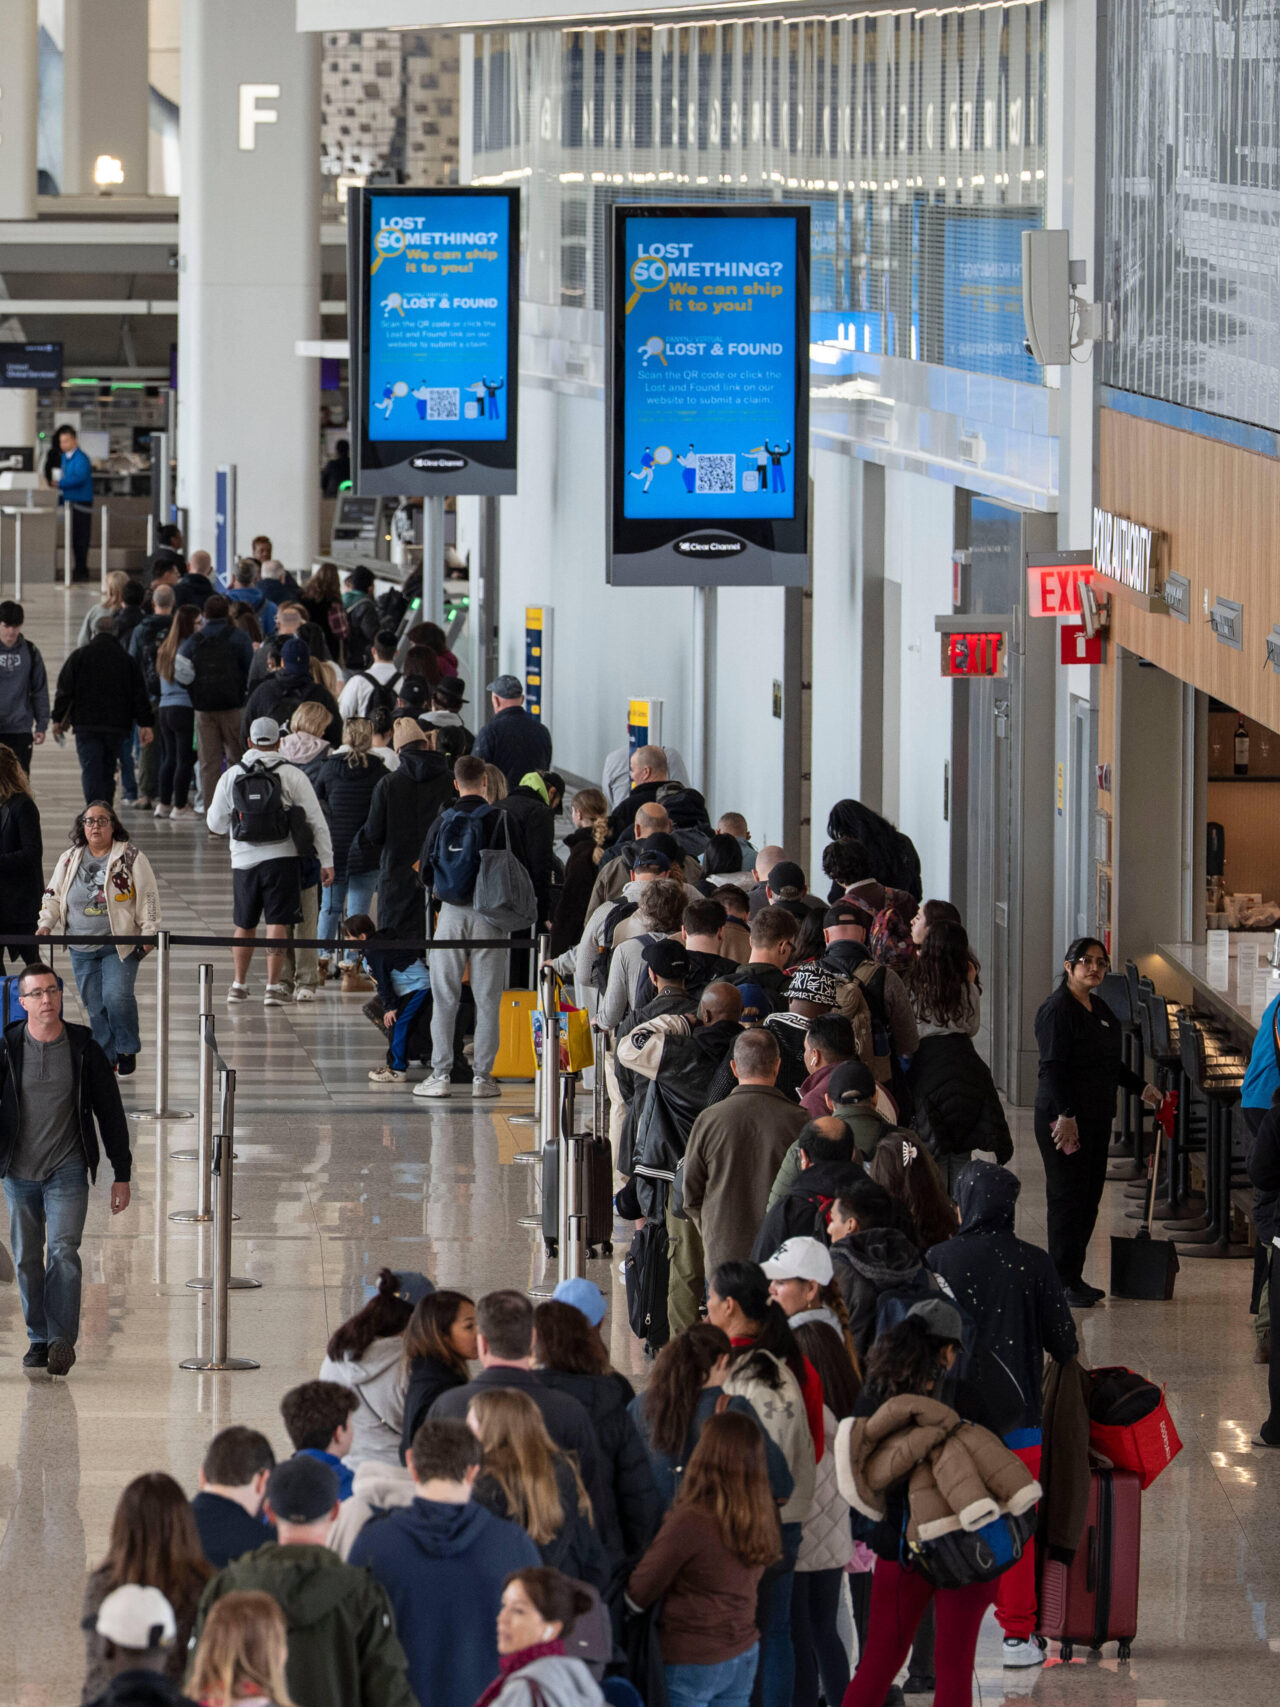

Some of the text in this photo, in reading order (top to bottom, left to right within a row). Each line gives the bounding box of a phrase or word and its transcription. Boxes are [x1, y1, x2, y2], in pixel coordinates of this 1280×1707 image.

[238, 83, 280, 151] F
[380, 217, 426, 230] LOST
[377, 231, 498, 249] SOMETHING?
[405, 248, 498, 262] We can ship
[637, 243, 693, 258] LOST
[405, 262, 474, 276] it to you!
[633, 262, 784, 281] SOMETHING?
[669, 281, 783, 299] We can ship
[403, 297, 499, 309] LOST & FOUND
[668, 298, 753, 315] it to you!
[665, 343, 783, 356] LOST & FOUND
[637, 370, 663, 380] Scan
[665, 370, 681, 380] the
[683, 370, 698, 381] QR
[701, 370, 726, 380] code
[740, 370, 763, 380] click
[765, 370, 782, 380] the
[645, 382, 775, 393] Lost and Found link on our
[647, 396, 685, 405] website
[686, 396, 697, 405] to
[700, 396, 733, 405] submit
[690, 542, 741, 551] Clear Channel
[1092, 506, 1153, 596] POUR AUTHORITY
[948, 632, 1003, 675] EXIT
